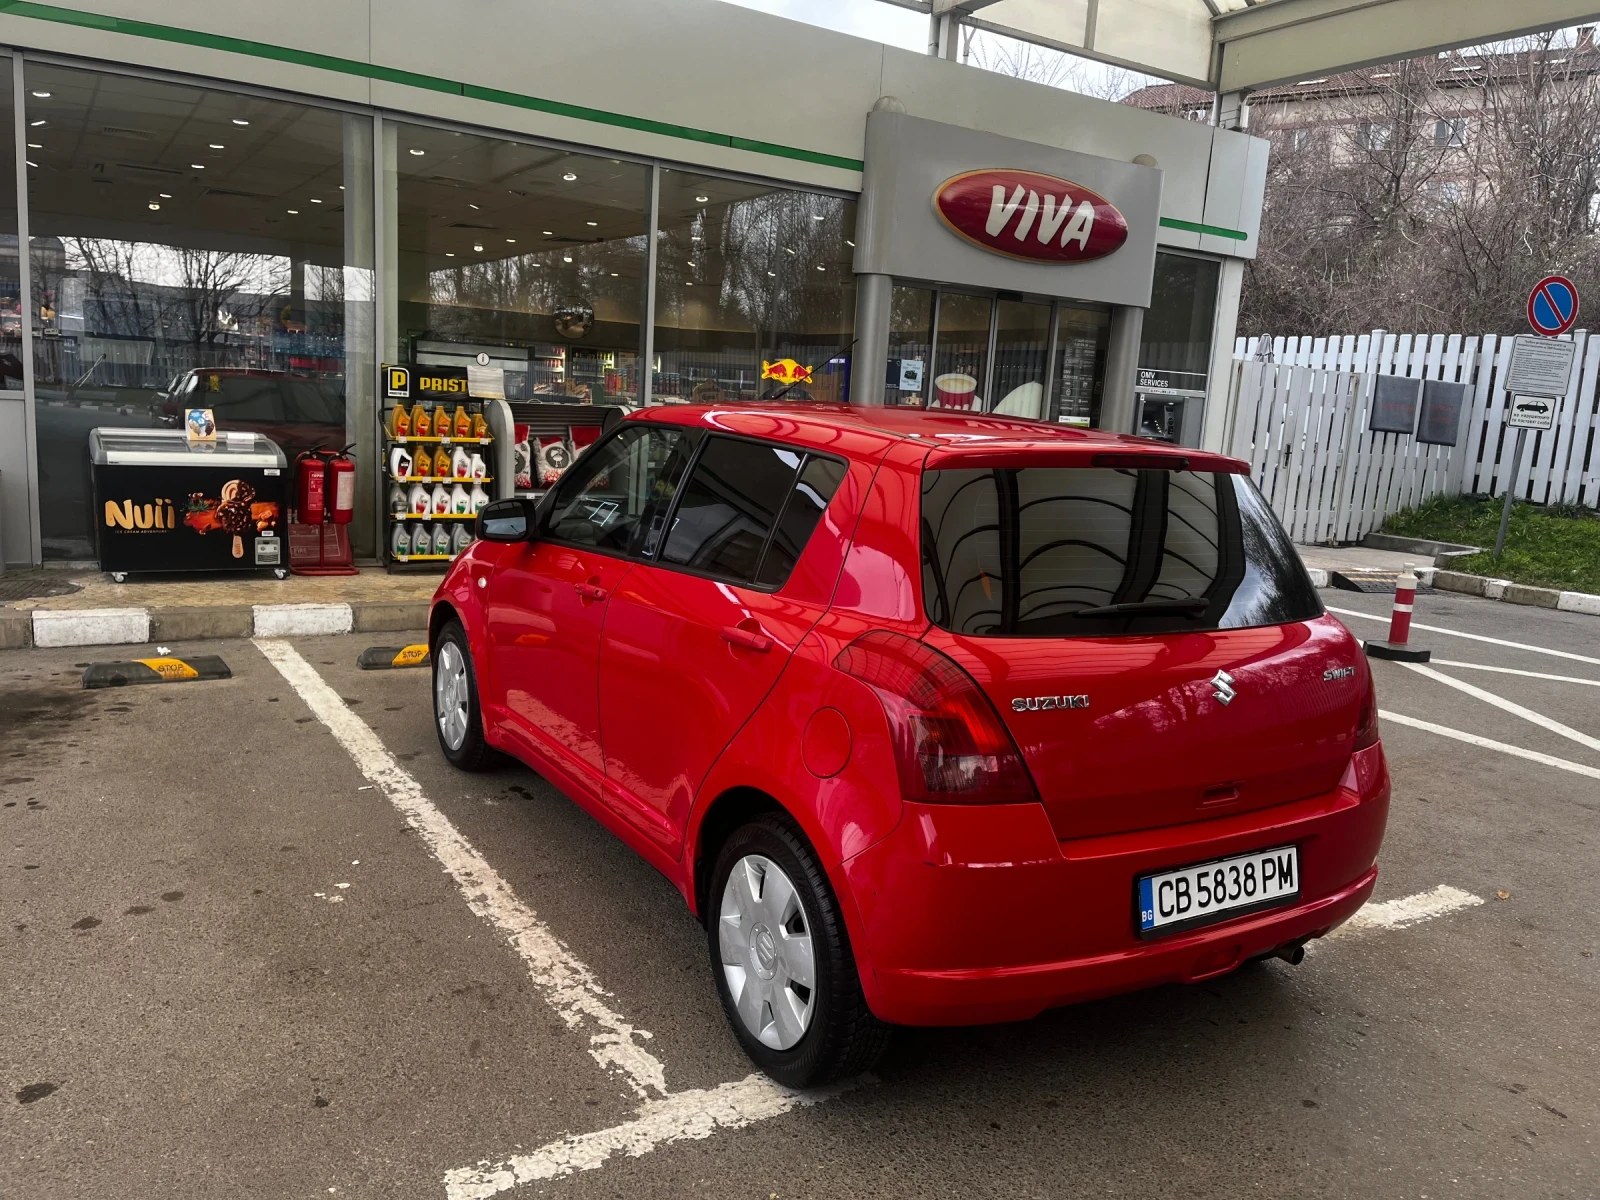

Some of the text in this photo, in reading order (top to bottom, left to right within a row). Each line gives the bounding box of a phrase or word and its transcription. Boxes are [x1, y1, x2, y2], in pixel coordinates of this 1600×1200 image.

[985, 183, 1095, 252] VIVA
[1140, 371, 1156, 379] OMV
[420, 377, 468, 392] PRIST
[1140, 379, 1169, 388] SERVICES
[105, 497, 175, 530] Nuii
[402, 650, 422, 660] STOP
[157, 664, 184, 673] STOP
[1322, 665, 1356, 683] SWIFT
[1011, 694, 1090, 712] SUZUKI
[1141, 853, 1294, 923] BG CB 5838 PM
